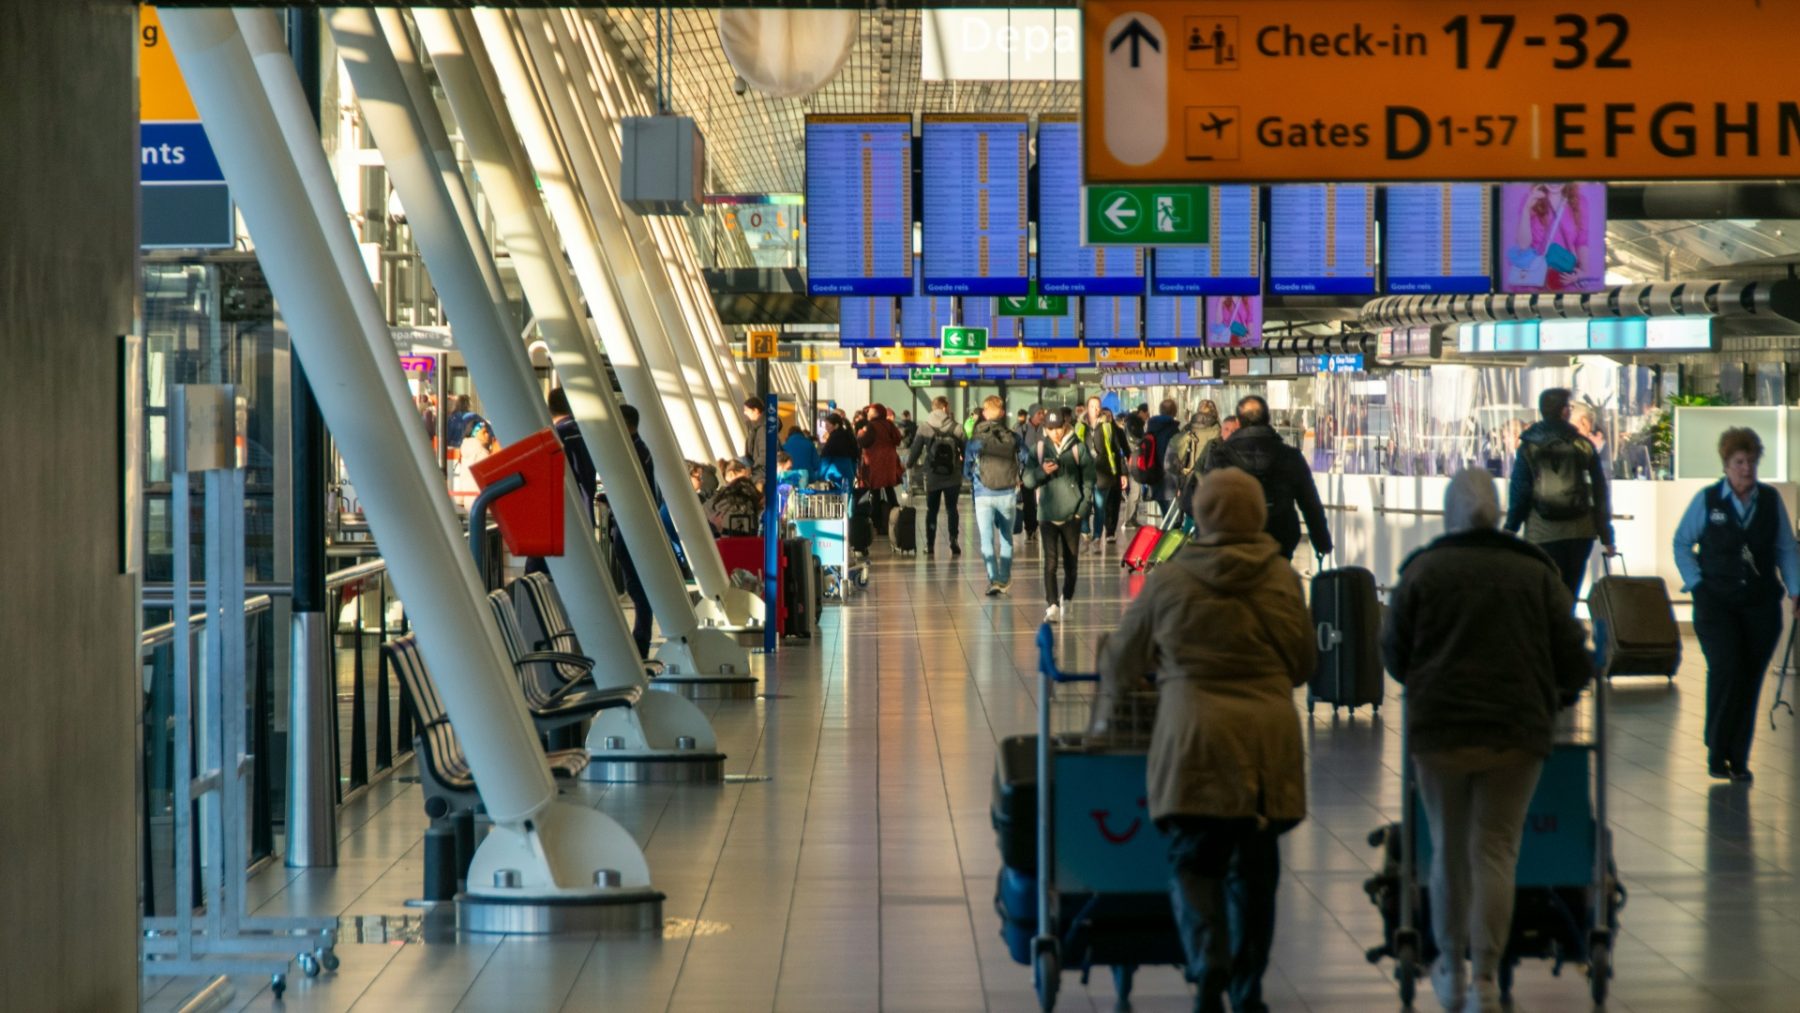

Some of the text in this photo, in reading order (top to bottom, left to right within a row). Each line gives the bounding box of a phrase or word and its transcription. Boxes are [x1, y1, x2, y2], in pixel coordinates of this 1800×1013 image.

[142, 24, 159, 48] g
[960, 16, 1077, 63] Depa
[1256, 13, 1632, 69] Check-in 17-32
[1256, 116, 1370, 148] Gates
[141, 143, 186, 164] nts
[812, 283, 854, 292] Goede reis
[927, 283, 969, 292] Goede reis
[1044, 283, 1085, 292] Goede reis
[1159, 283, 1200, 292] Goede reis
[1274, 283, 1316, 292] Goede reis
[1390, 283, 1432, 292] Goede reis
